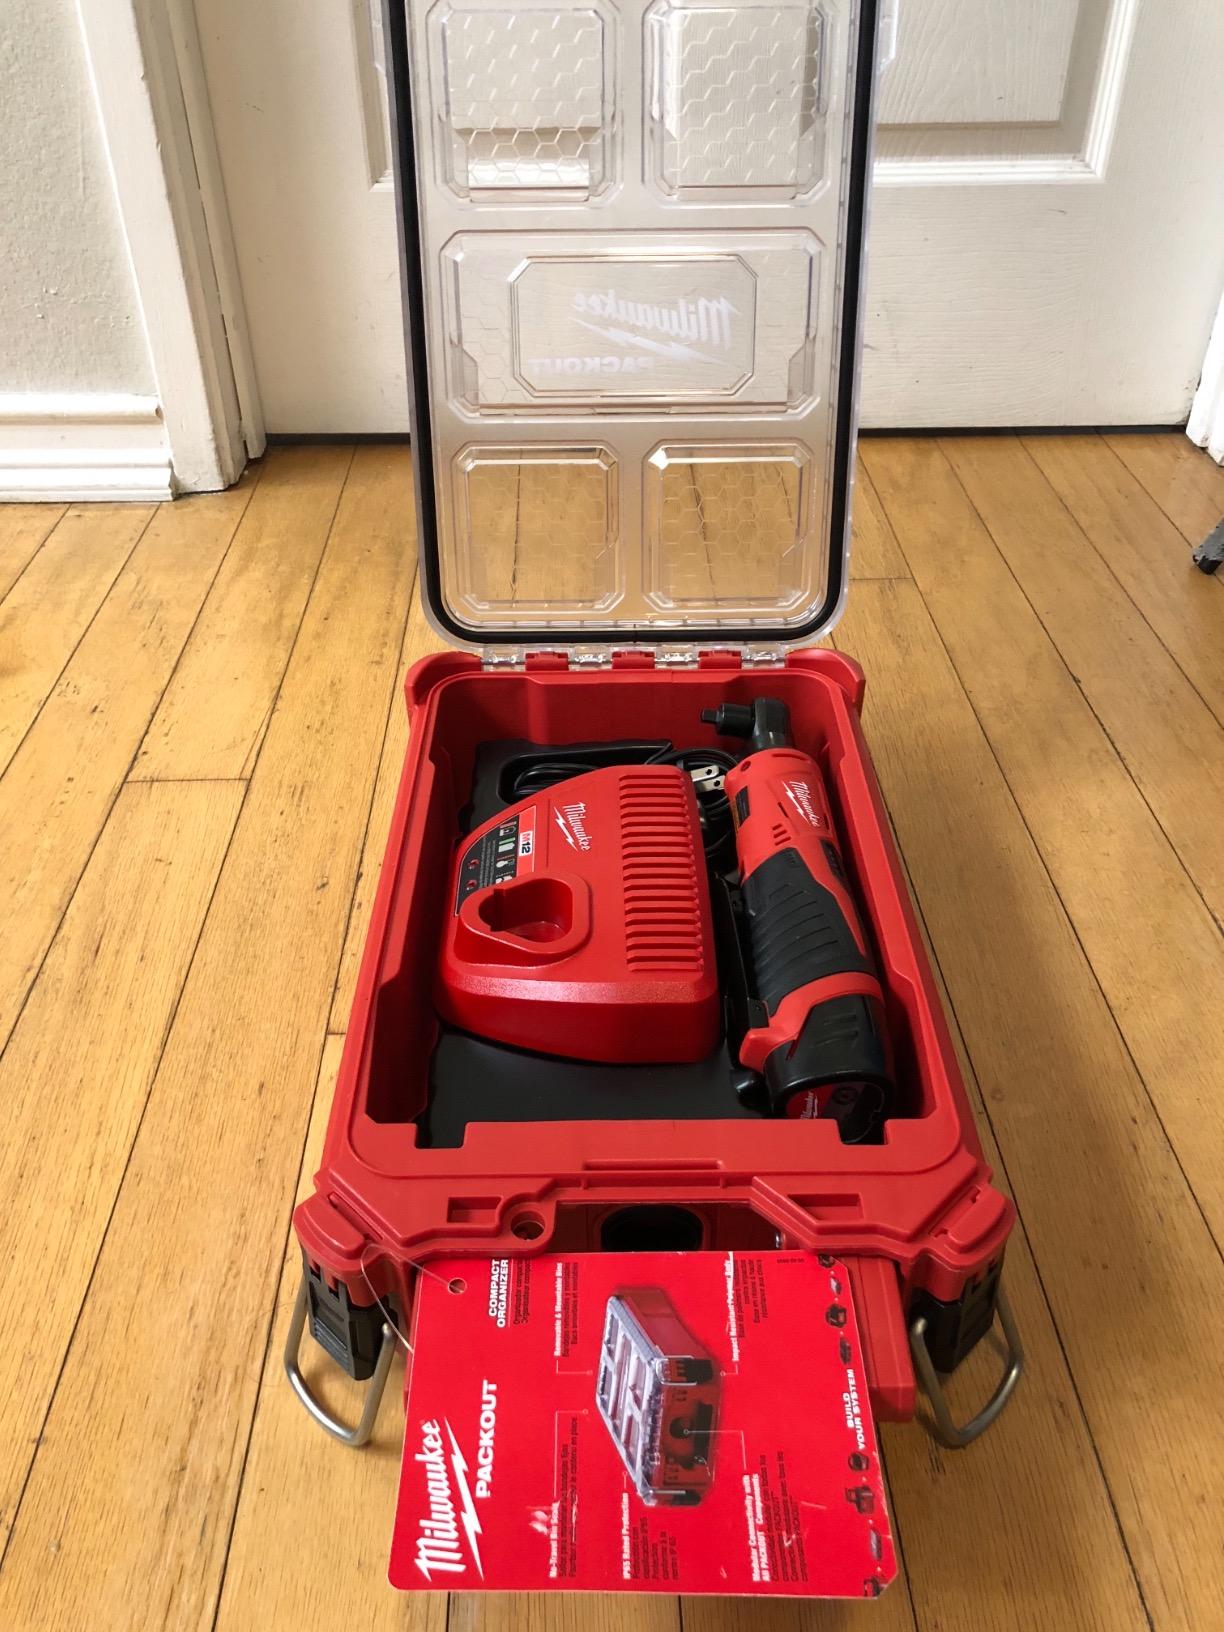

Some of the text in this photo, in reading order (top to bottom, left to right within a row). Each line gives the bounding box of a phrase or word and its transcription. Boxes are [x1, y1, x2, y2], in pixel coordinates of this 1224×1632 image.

[562, 801, 592, 851] Milwaukee
[789, 781, 820, 827] Milwaukee
[521, 833, 532, 854] M12
[488, 1259, 500, 1317] COMPACT
[497, 1259, 509, 1328] ORGANIZER
[731, 1338, 740, 1361] Impact
[842, 1392, 855, 1428] BUILD
[846, 1368, 866, 1450] YOUR SYSTEM
[475, 1380, 497, 1498] PACKOUT
[413, 1419, 467, 1582] Milwaukee
[745, 1495, 757, 1546] Connectivity
[752, 1474, 764, 1524] Components
[621, 1493, 631, 1579] IP65 Rated Protection
[750, 1547, 761, 1581] Modular
